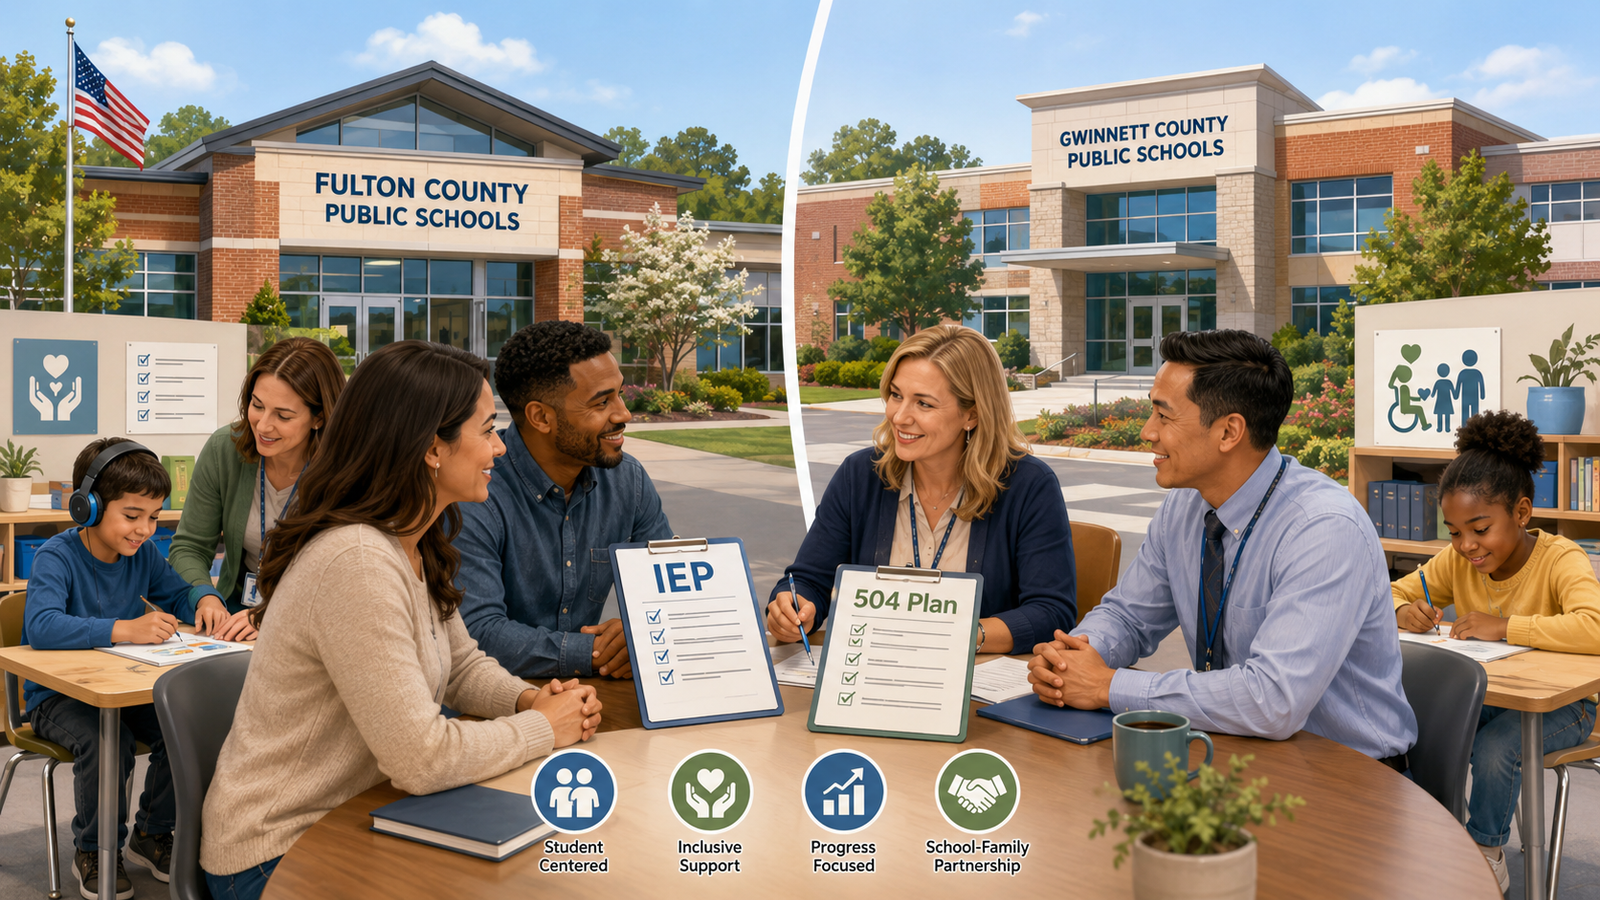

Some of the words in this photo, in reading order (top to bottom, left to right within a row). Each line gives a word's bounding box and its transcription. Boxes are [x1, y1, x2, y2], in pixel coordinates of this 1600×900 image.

[1059, 123, 1150, 147] GWINNETT
[1154, 115, 1228, 138] COUNTY
[1068, 147, 1131, 169] PUBLIC
[1136, 139, 1224, 163] SCHOOLS
[315, 172, 415, 199] FULTON
[424, 178, 529, 205] COUNTY
[325, 203, 408, 227] PUBLIC
[415, 207, 520, 231] SCHOOLS
[654, 561, 714, 594] IEP
[853, 588, 901, 612] 504
[906, 592, 958, 616] Plan
